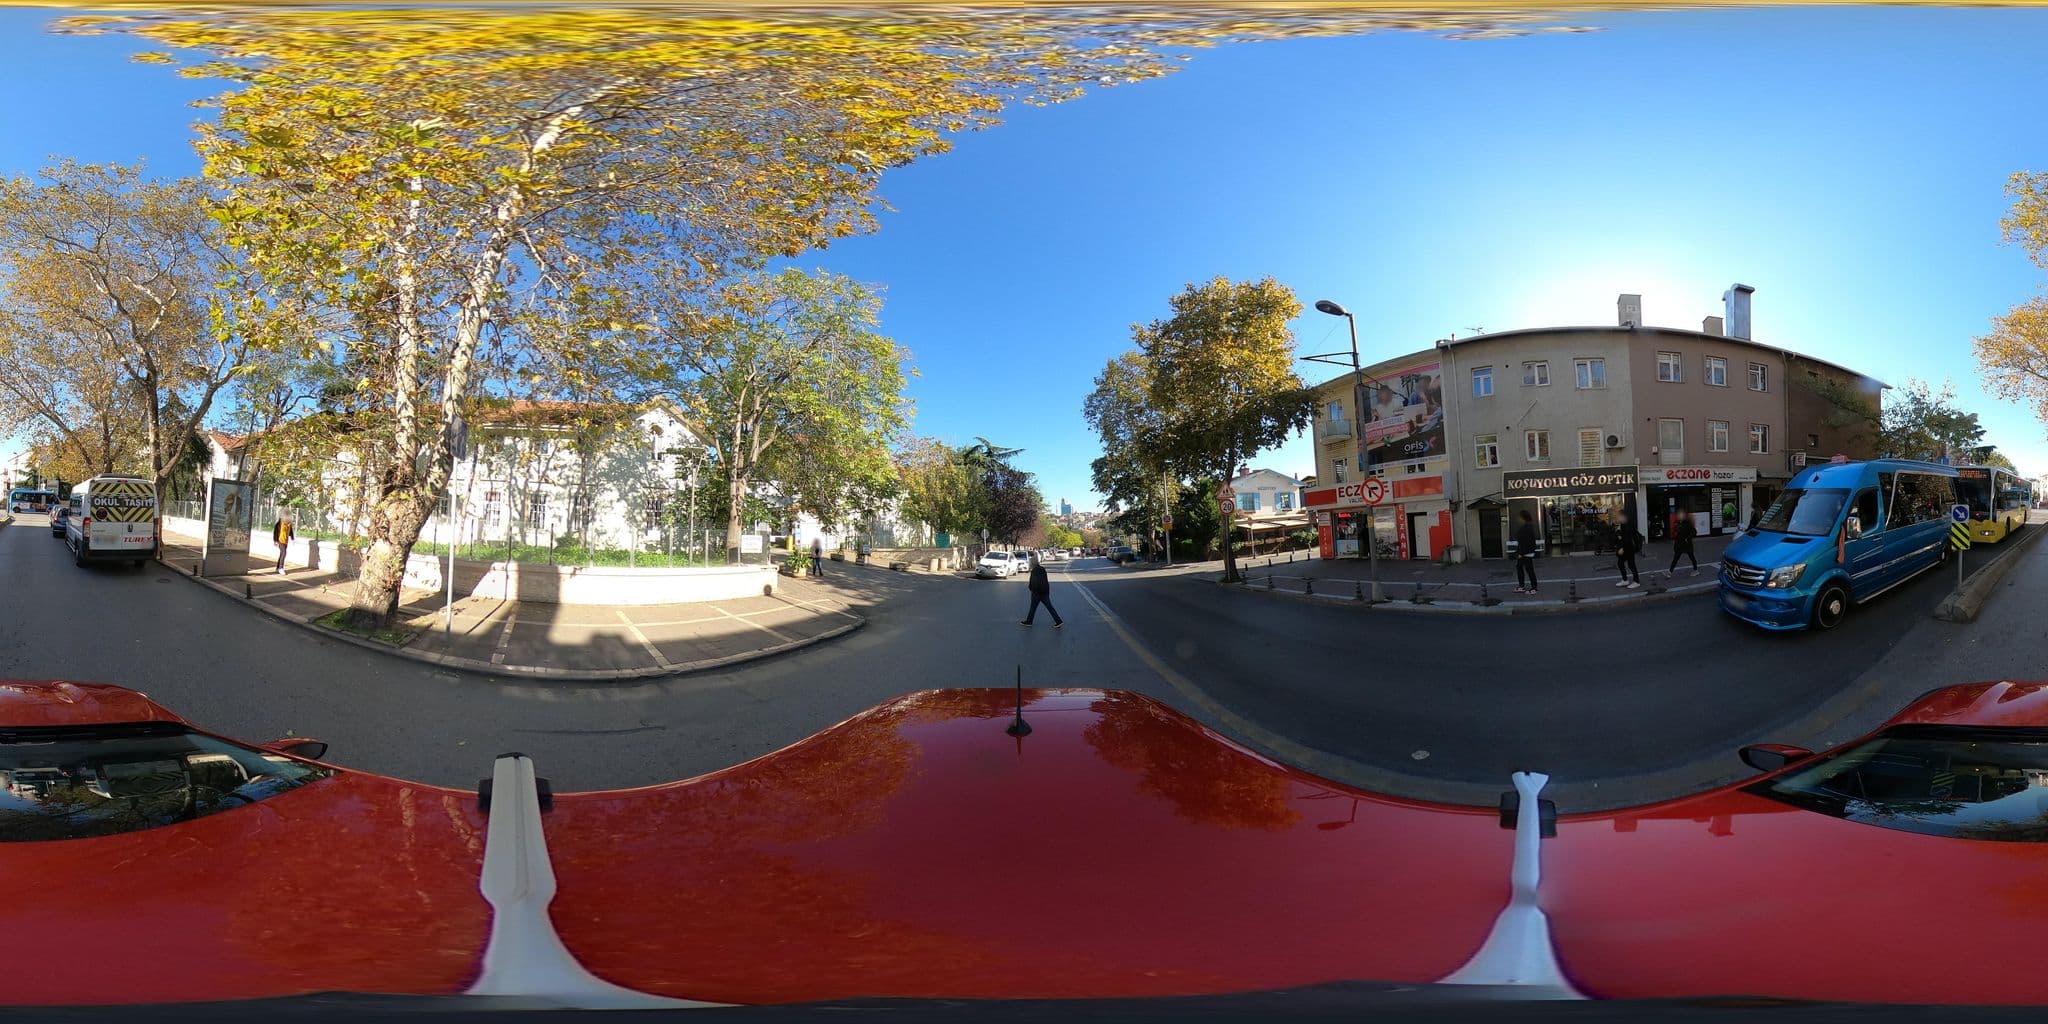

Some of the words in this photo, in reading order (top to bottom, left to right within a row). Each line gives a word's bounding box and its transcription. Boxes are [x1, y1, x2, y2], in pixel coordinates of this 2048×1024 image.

[1666, 468, 1711, 479] eczane
[1713, 470, 1735, 479] hazar
[1507, 477, 1568, 490] KOŞUYOLU
[1570, 473, 1595, 486] GÖZ
[1598, 472, 1635, 485] OPTİK
[1338, 481, 1390, 498] ECZE
[94, 498, 120, 506] OKUL
[1223, 503, 1232, 511] 20
[1398, 504, 1408, 558] ECZANE
